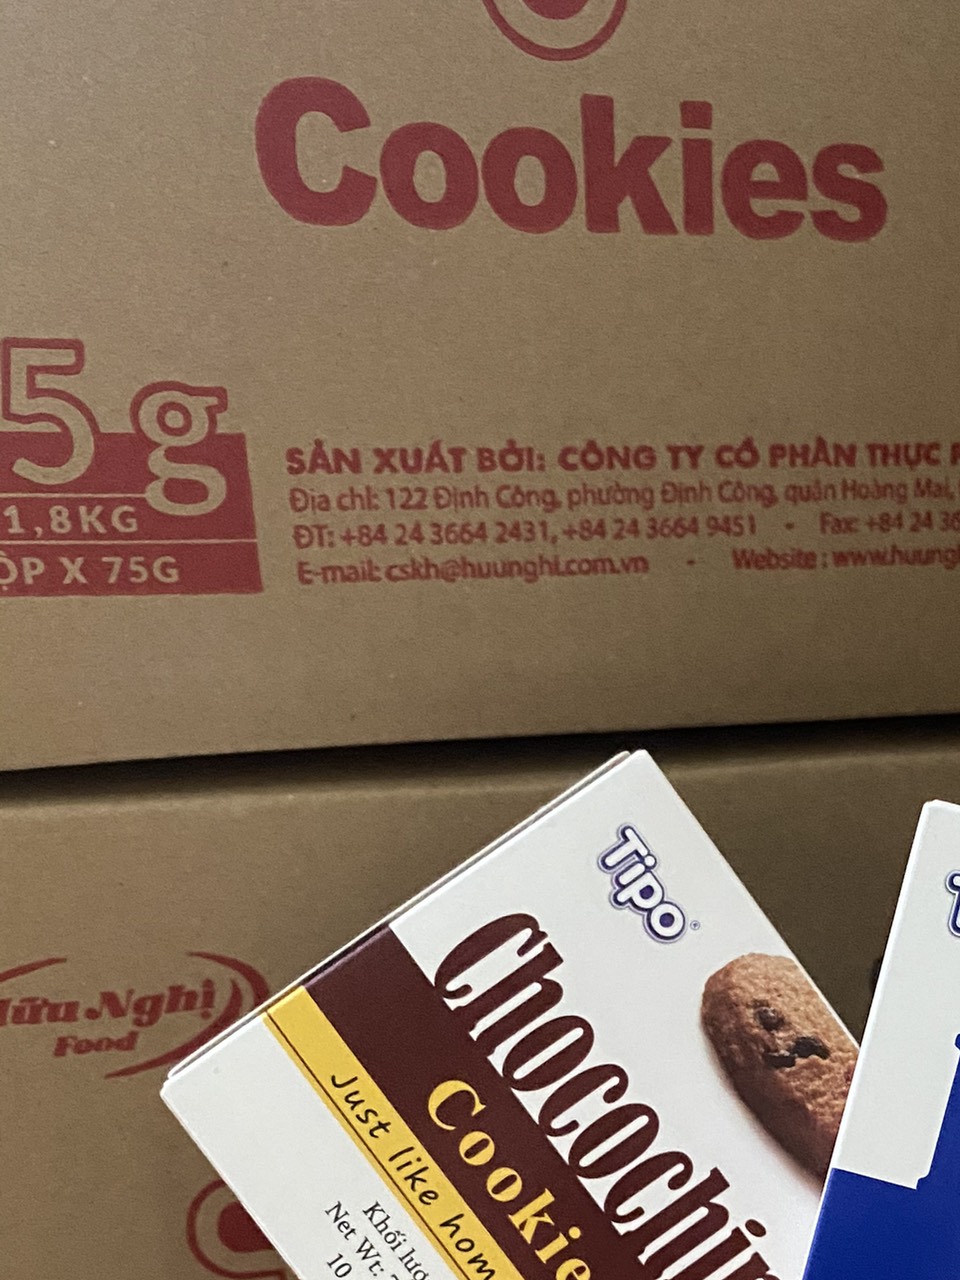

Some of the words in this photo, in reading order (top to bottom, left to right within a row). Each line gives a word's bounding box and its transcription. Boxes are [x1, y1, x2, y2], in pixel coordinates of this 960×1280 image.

[254, 76, 888, 243] Cookies
[286, 438, 362, 475] SẢN
[558, 439, 657, 471] CÔNG
[666, 444, 704, 470] TY
[865, 442, 941, 471] THỰC
[386, 486, 428, 510] 122
[3, 504, 139, 538] 1,8KG
[341, 523, 388, 547] +84
[395, 521, 426, 546] 24
[430, 520, 489, 545] 3664
[563, 518, 607, 541] +84
[613, 517, 640, 540] 24
[646, 515, 699, 540] 3664
[706, 513, 756, 537] 9451
[59, 557, 88, 585] X
[102, 555, 180, 584] 75G
[597, 822, 688, 943] Tipo
[53, 1030, 139, 1057] Food
[330, 1074, 391, 1139] Just
[388, 1145, 439, 1206] like
[325, 1200, 357, 1240] Net
[355, 1236, 385, 1277] Wt:
[362, 1200, 408, 1252] Khối
[326, 1252, 353, 1279] 10
